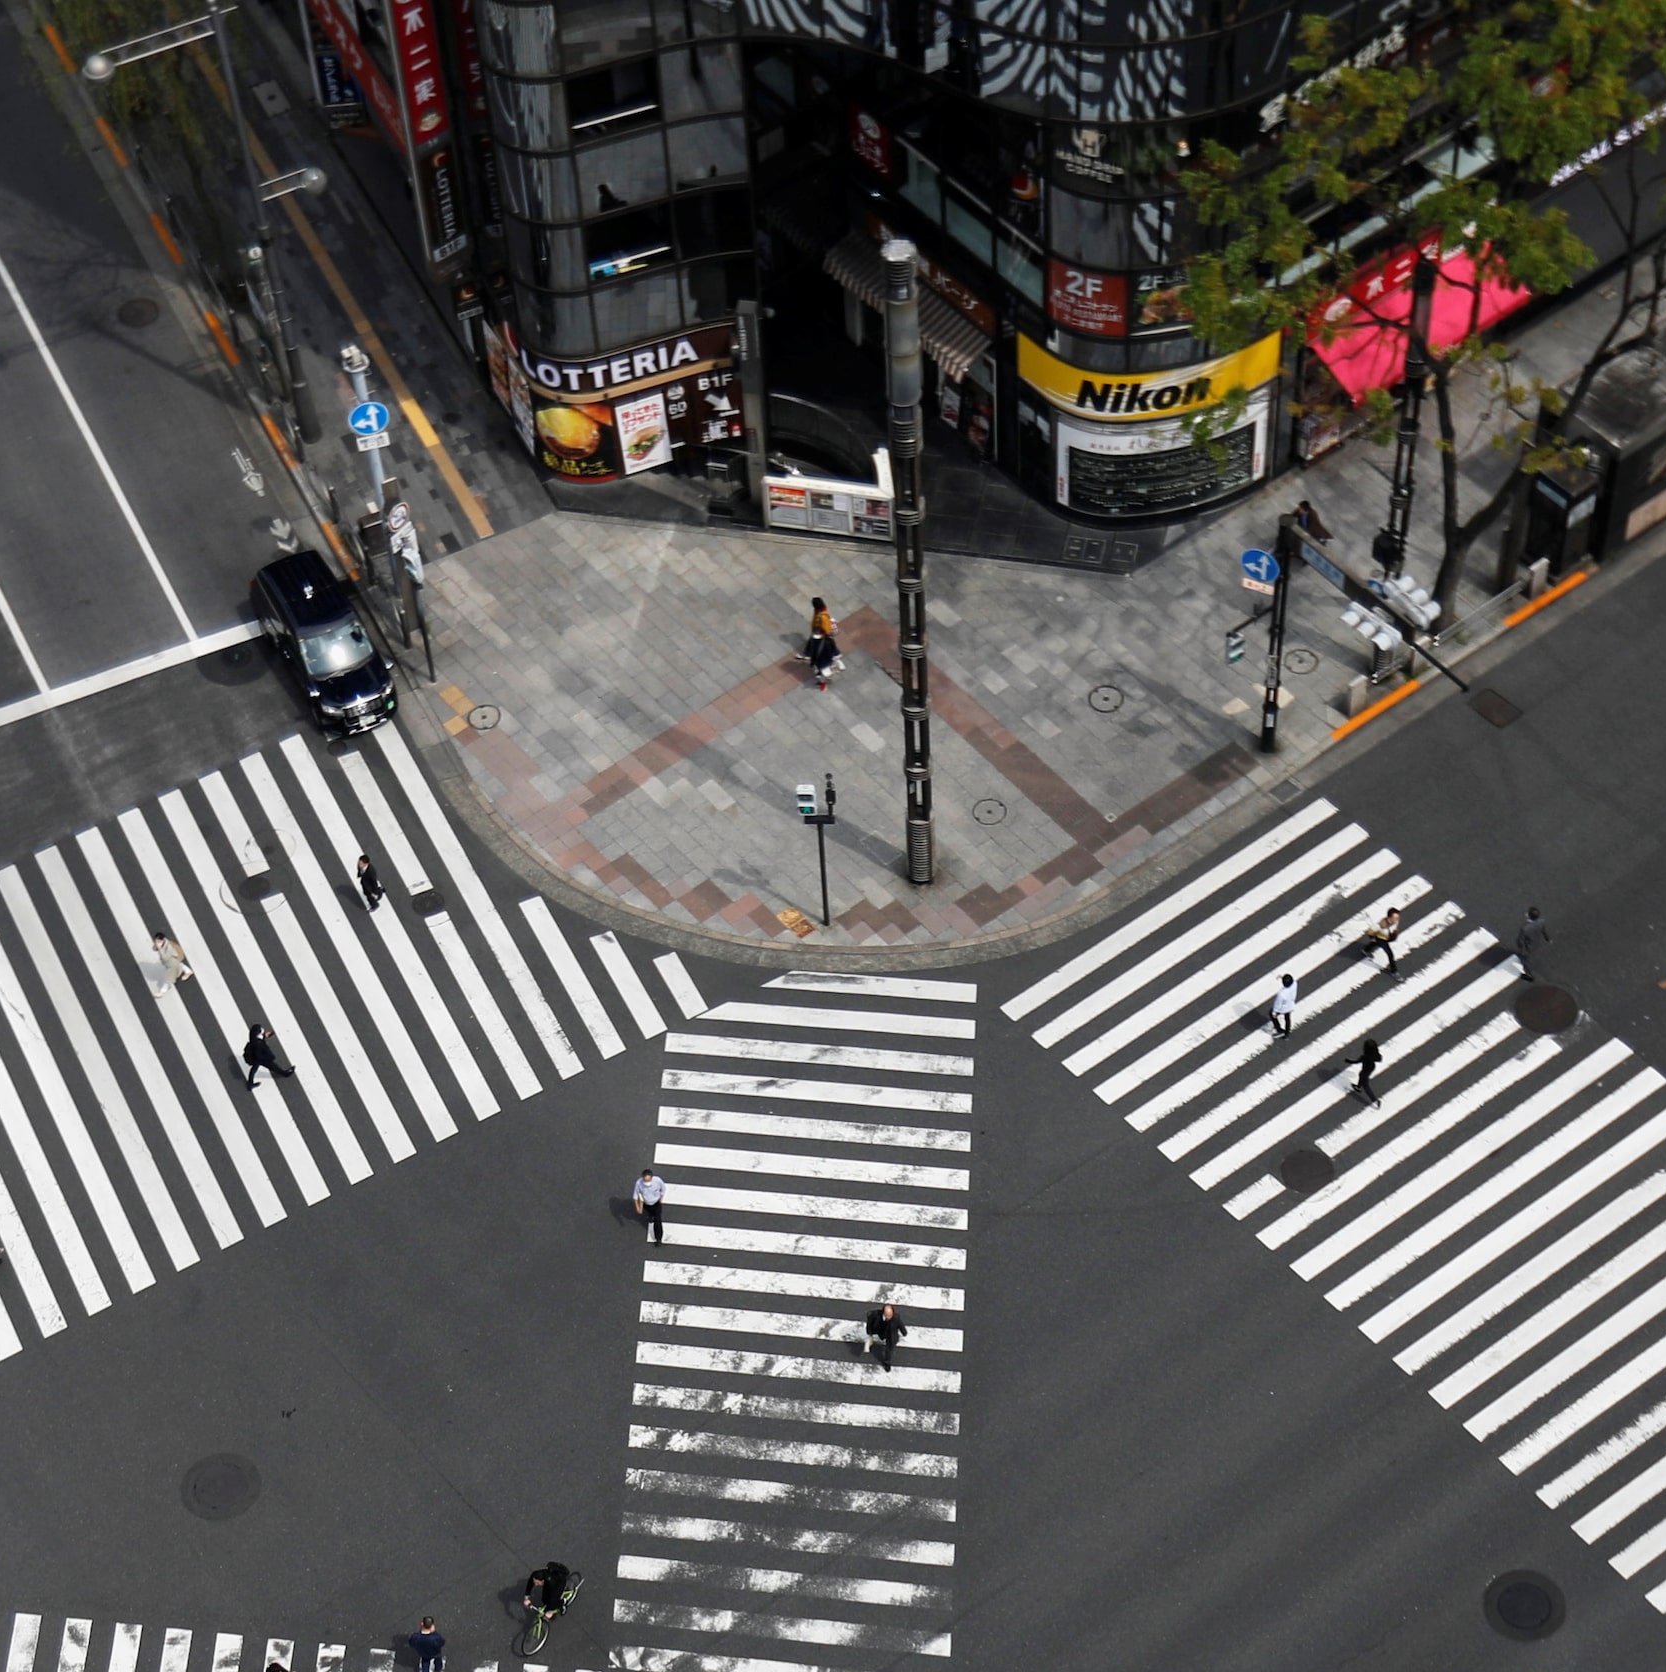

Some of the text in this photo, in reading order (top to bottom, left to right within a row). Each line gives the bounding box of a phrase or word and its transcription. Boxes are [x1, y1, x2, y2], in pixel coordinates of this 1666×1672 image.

[402, 7, 437, 105] 不二家
[1065, 163, 1114, 184] COFFEE
[435, 168, 457, 240] LOTTERIA
[1065, 270, 1104, 299] 2F
[520, 337, 699, 392] LOTTERIA
[697, 373, 733, 391] B1F
[1076, 378, 1213, 413] Nikon
